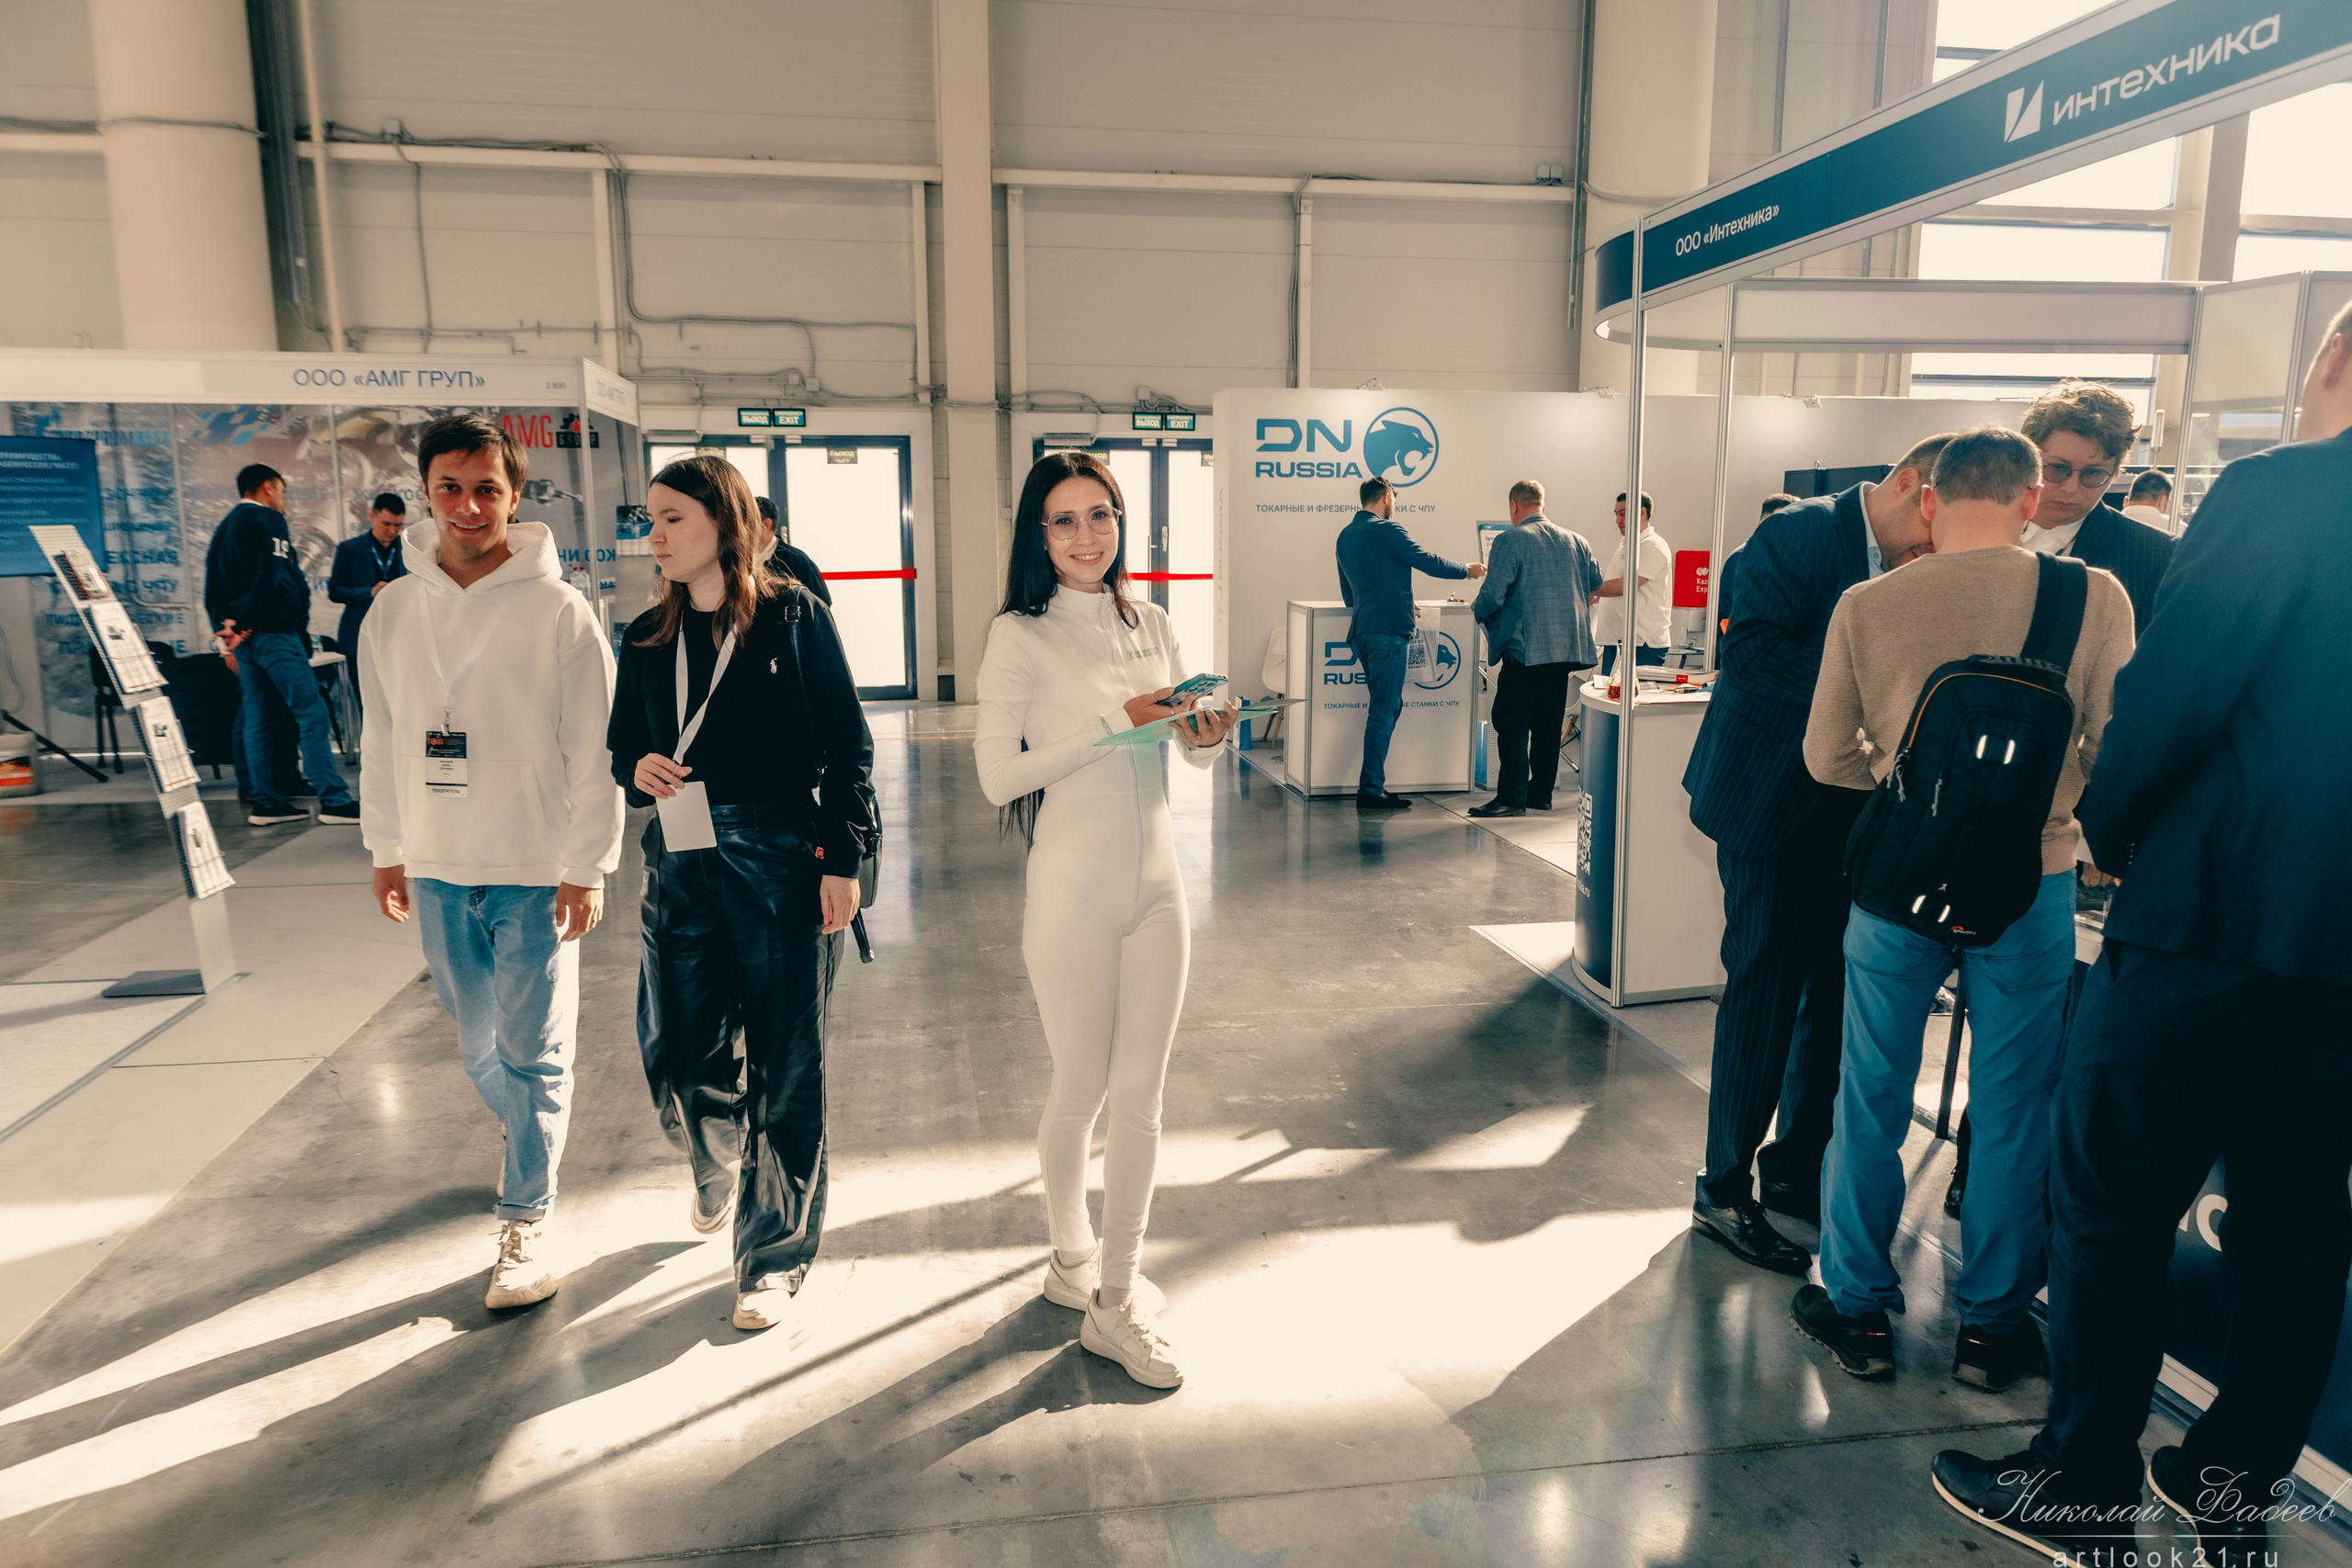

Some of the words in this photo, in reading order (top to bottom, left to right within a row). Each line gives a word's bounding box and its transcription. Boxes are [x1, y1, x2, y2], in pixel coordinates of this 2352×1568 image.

[1676, 231, 1701, 256] ООО
[1703, 205, 1780, 244] «Интехника»
[293, 369, 345, 387] ООО
[353, 370, 411, 388] «АМГ
[417, 370, 486, 389] ГРУП»
[778, 416, 799, 424] EXIT
[1136, 419, 1160, 428] ВЫХОД
[502, 413, 554, 448] AMG
[1256, 418, 1352, 453] DN
[559, 434, 597, 446] GROP
[1255, 461, 1363, 479] RUSSIA
[1256, 504, 1305, 513] ТОКАРНЫЕ
[1324, 672, 1367, 685] RUS
